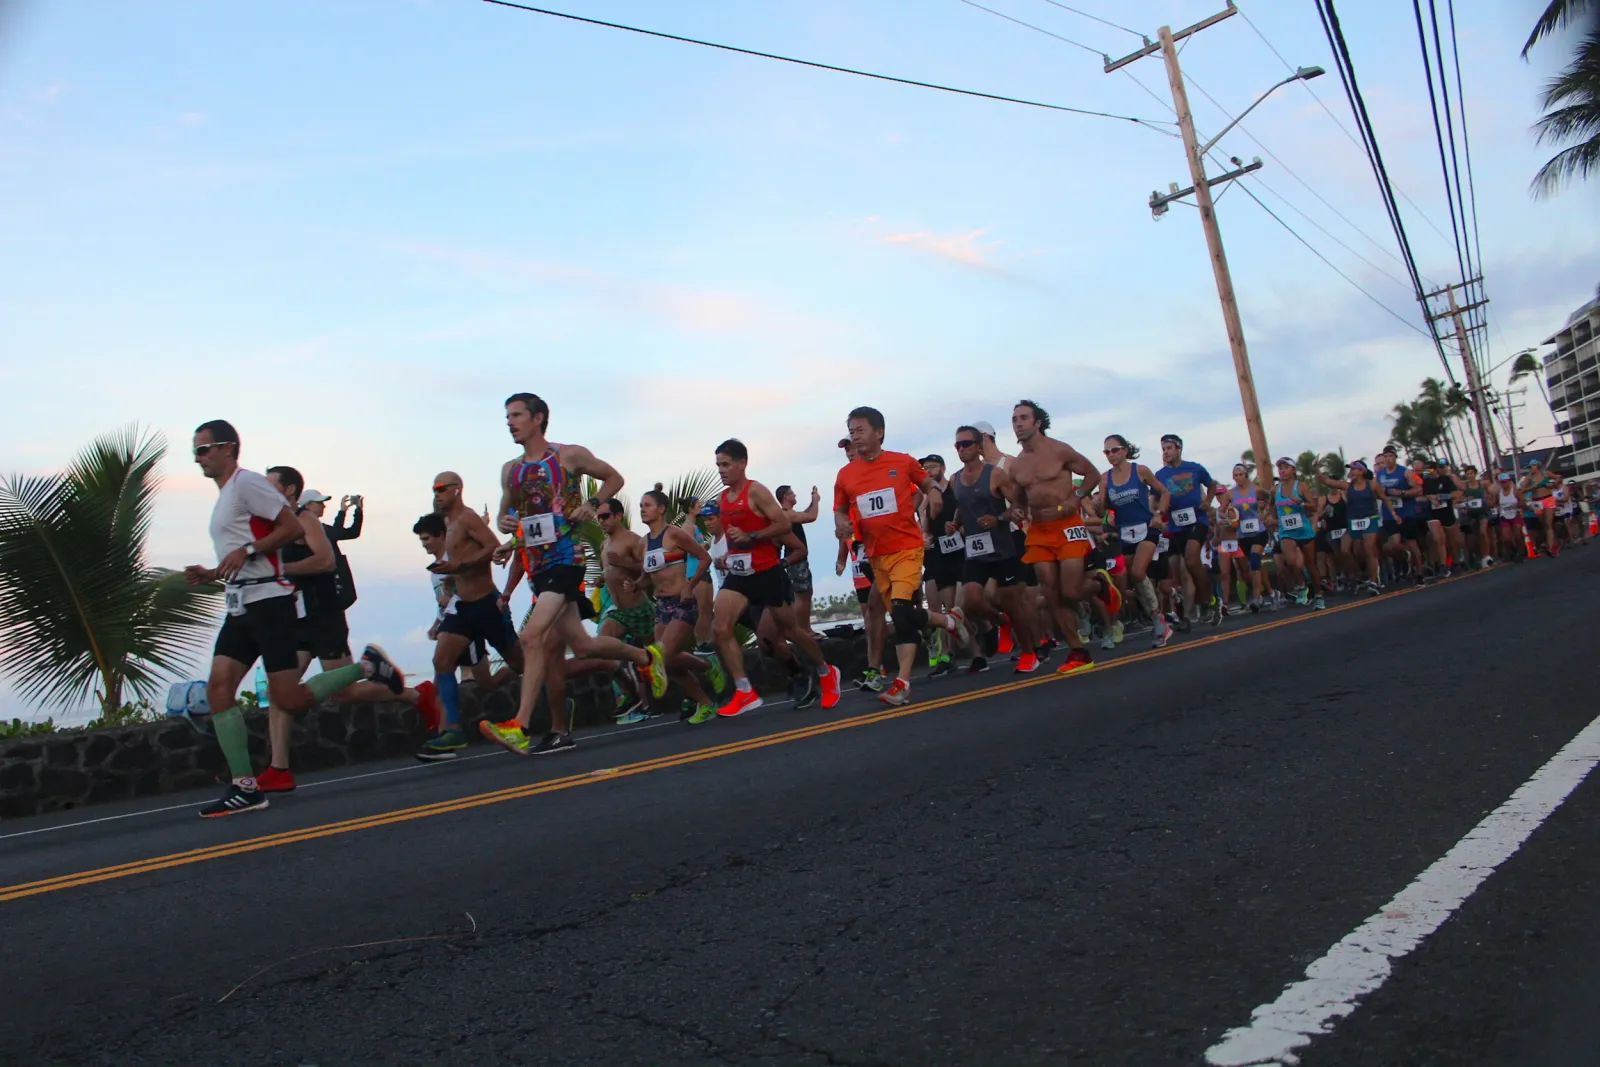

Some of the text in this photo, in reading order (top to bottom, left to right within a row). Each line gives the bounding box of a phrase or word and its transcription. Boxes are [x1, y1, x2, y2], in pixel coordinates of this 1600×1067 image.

[869, 496, 884, 511] 70
[1178, 512, 1190, 522] 59
[1284, 518, 1297, 526] 197
[529, 522, 542, 539] 44
[1067, 526, 1088, 540] 203
[943, 537, 957, 549] 141
[972, 539, 984, 551] 45
[647, 555, 657, 567] 26
